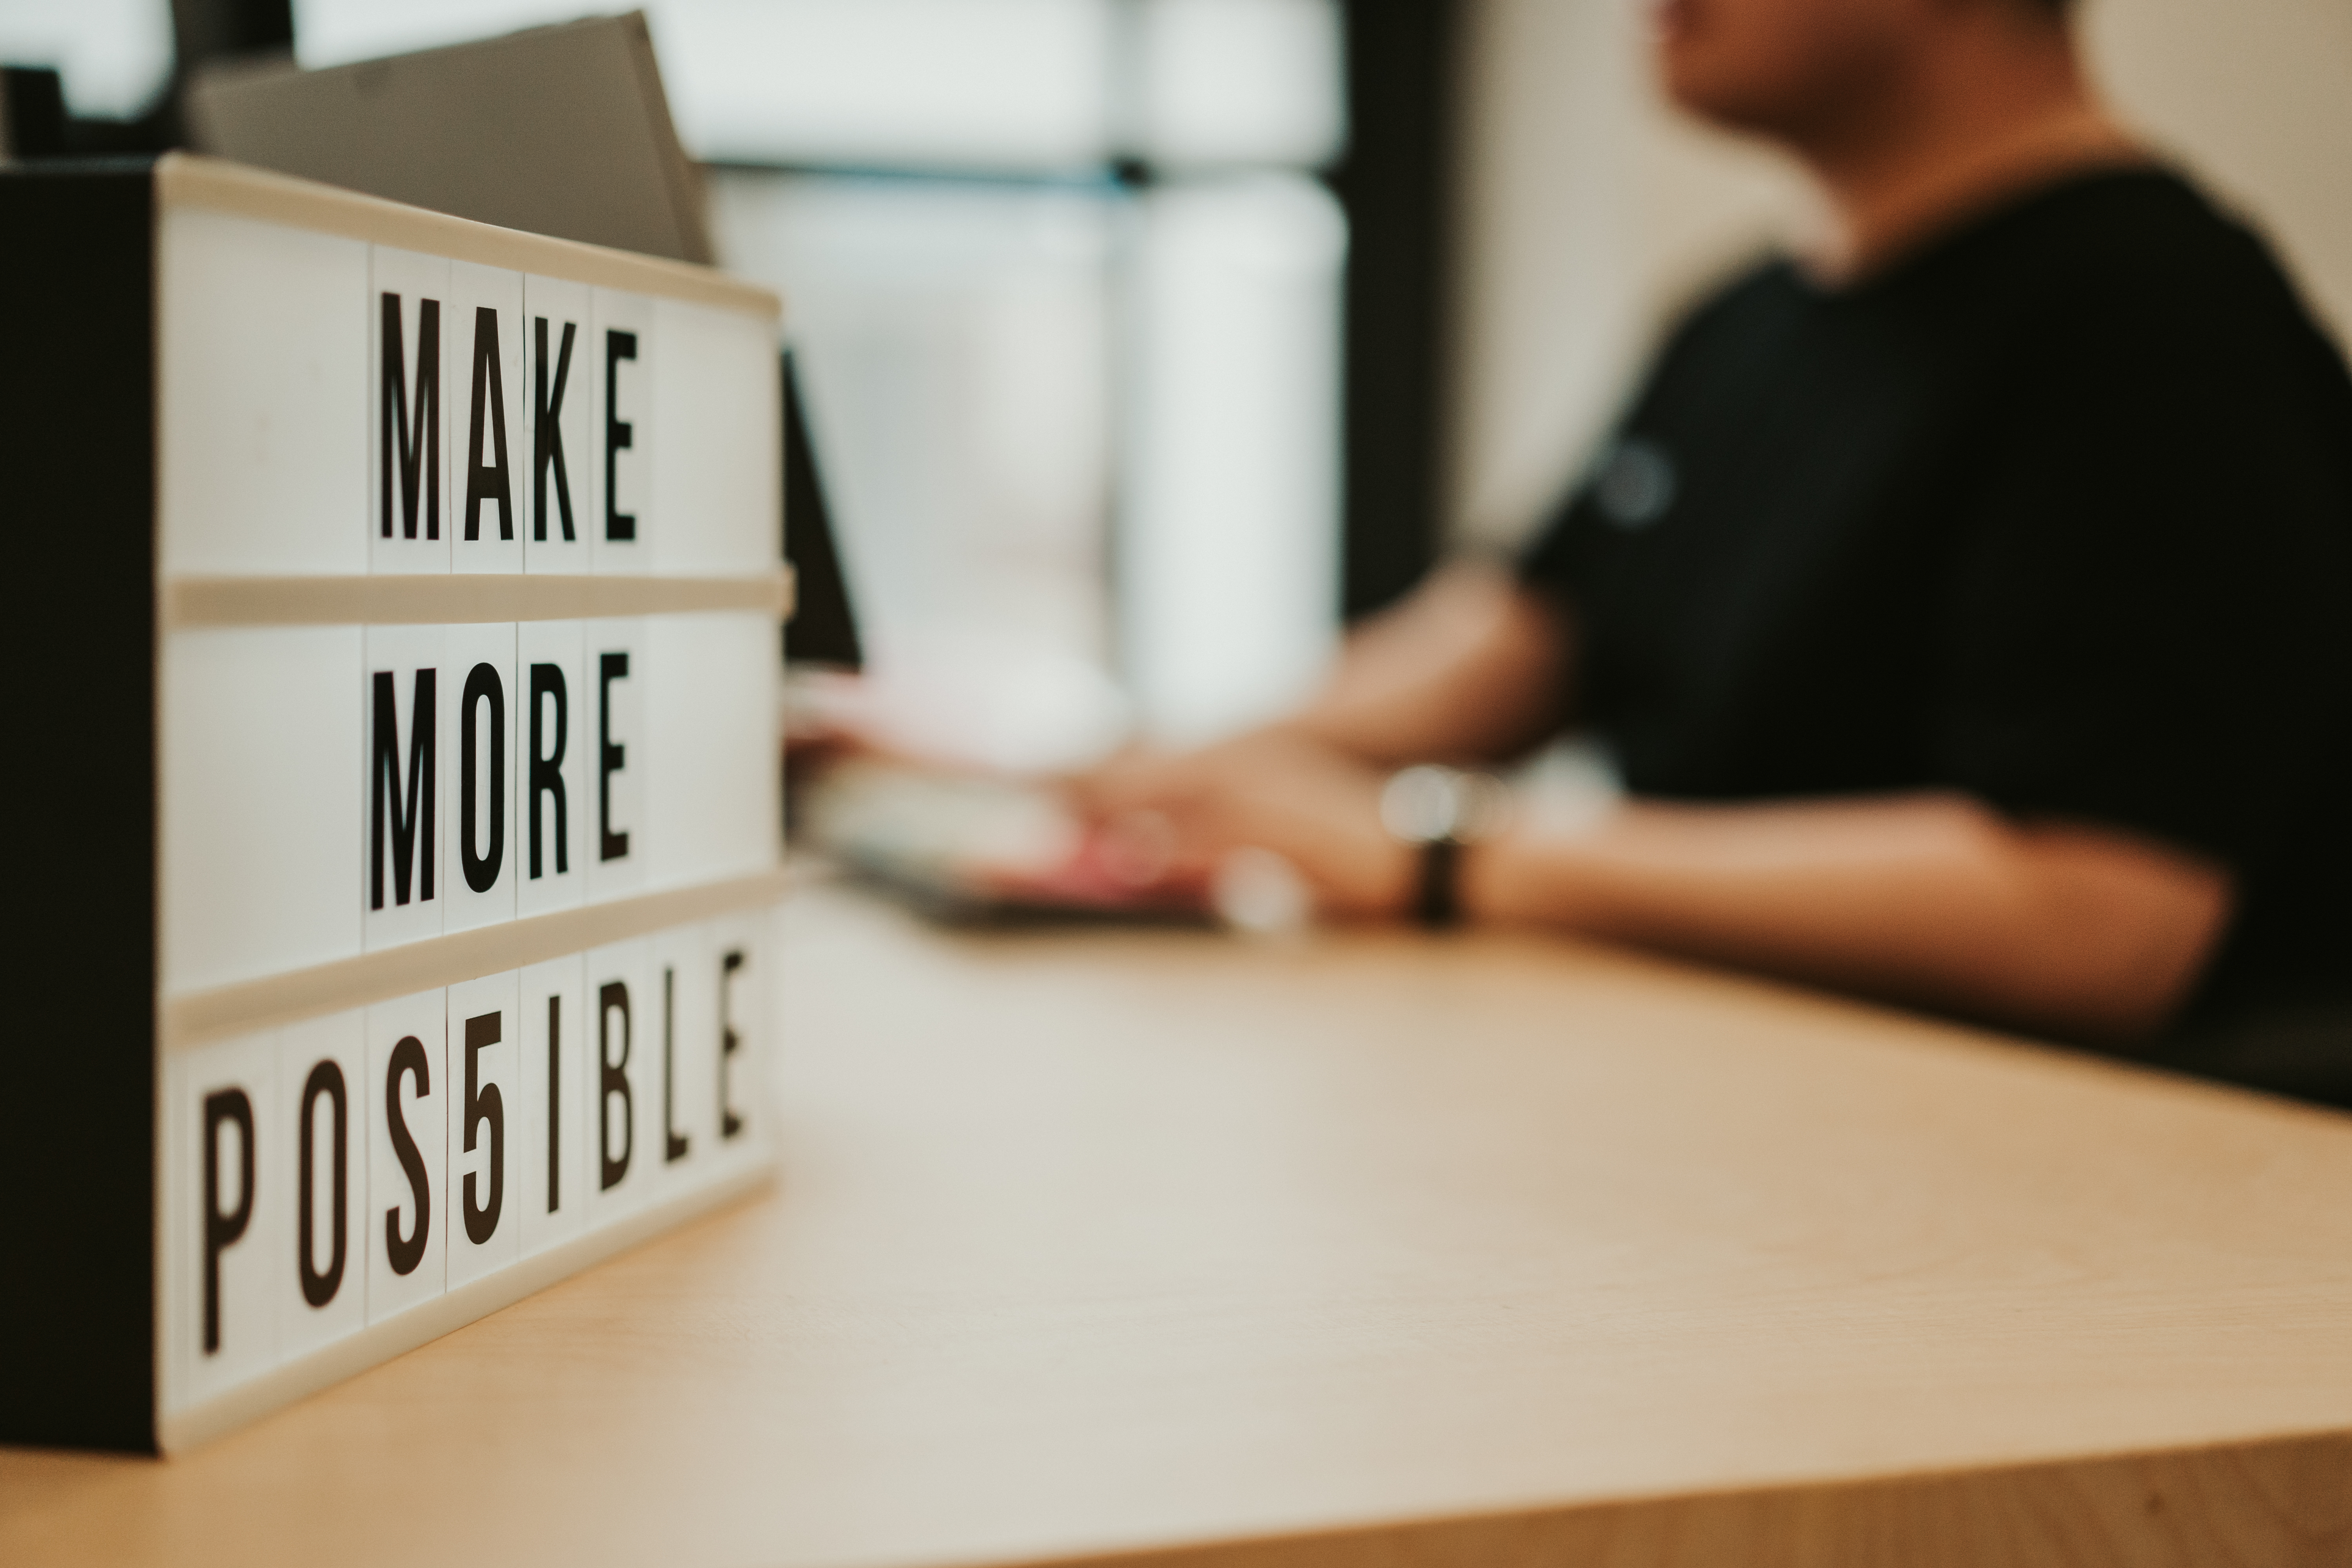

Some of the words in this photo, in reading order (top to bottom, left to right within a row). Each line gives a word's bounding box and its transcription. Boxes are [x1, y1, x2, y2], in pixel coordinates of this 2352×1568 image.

[380, 291, 638, 542] MAKE
[369, 652, 630, 912] MORE
[201, 948, 747, 1356] POS5IBLE
